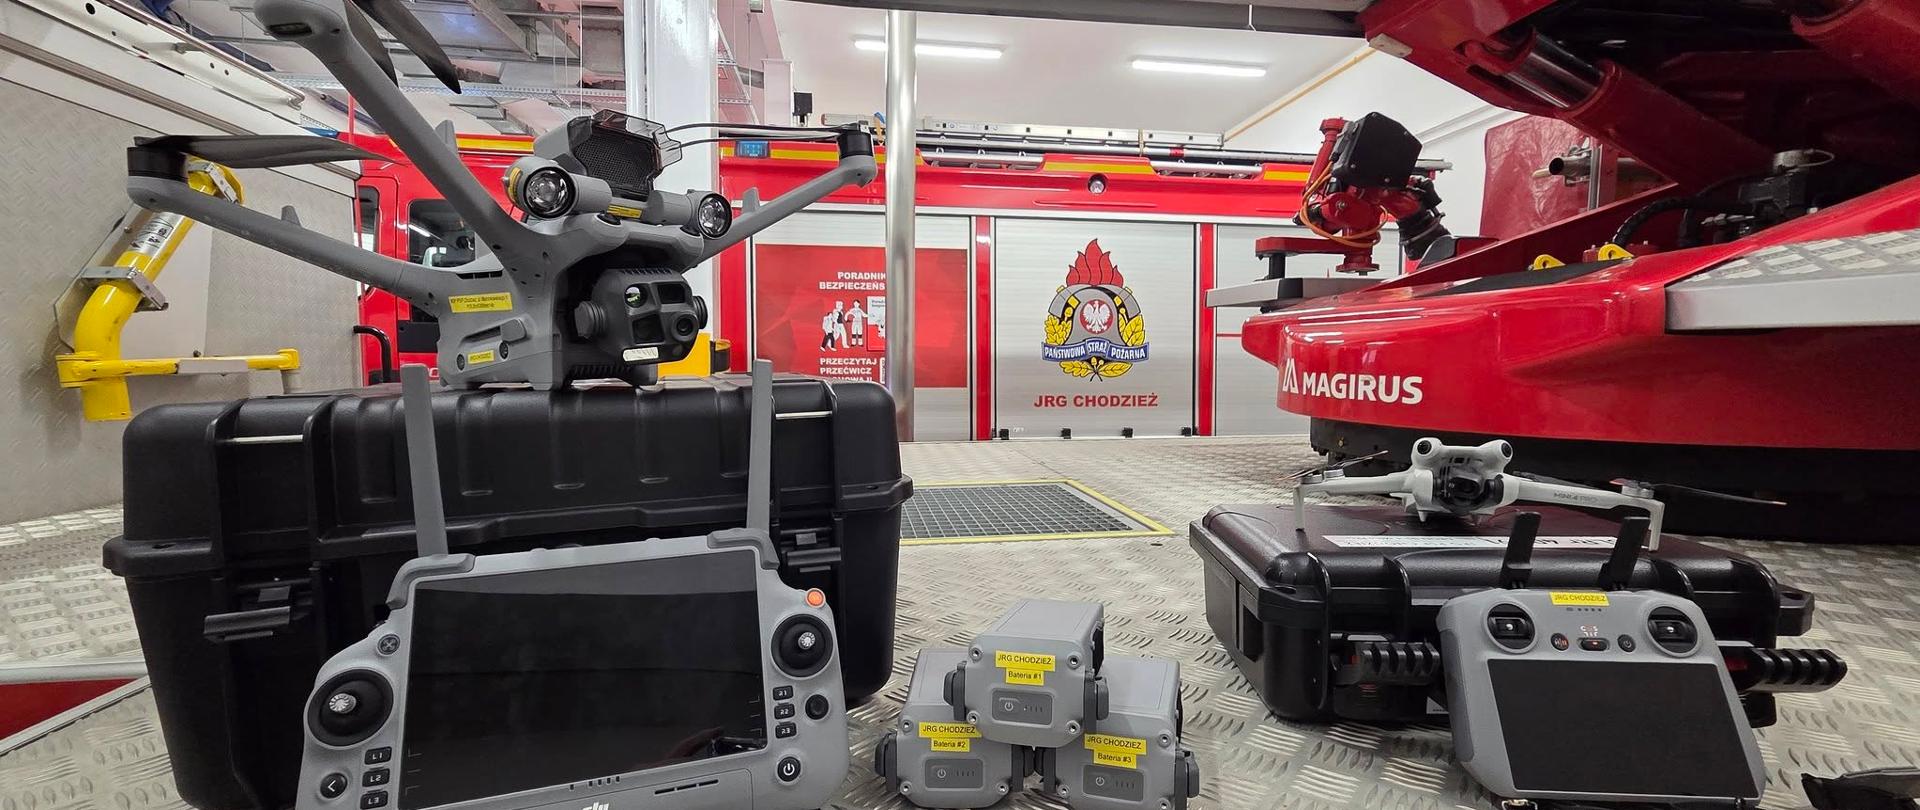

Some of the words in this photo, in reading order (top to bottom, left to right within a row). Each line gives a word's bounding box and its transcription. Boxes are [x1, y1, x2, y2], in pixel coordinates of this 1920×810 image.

[819, 280, 886, 290] BEZPIECZEŃS
[1044, 345, 1086, 359] PAŃSTWOWA
[1087, 341, 1107, 354] STRAŻ
[1111, 348, 1146, 360] POŻARNA
[820, 358, 878, 366] PRZECZYTAJ
[820, 367, 872, 375] PRZEĆWICZ
[1302, 371, 1424, 405] MAGIRUS
[1034, 395, 1067, 408] JRG
[1073, 392, 1158, 407] CHODZIEŻ
[998, 654, 1012, 662] JRG
[1008, 671, 1032, 680] Bateria
[923, 725, 937, 733] JRG
[933, 740, 956, 748] Bateria
[1087, 736, 1102, 744] JRG
[372, 752, 383, 760] L1
[1097, 753, 1121, 762] Bateria
[370, 775, 381, 783] L2
[368, 797, 380, 805] L3
